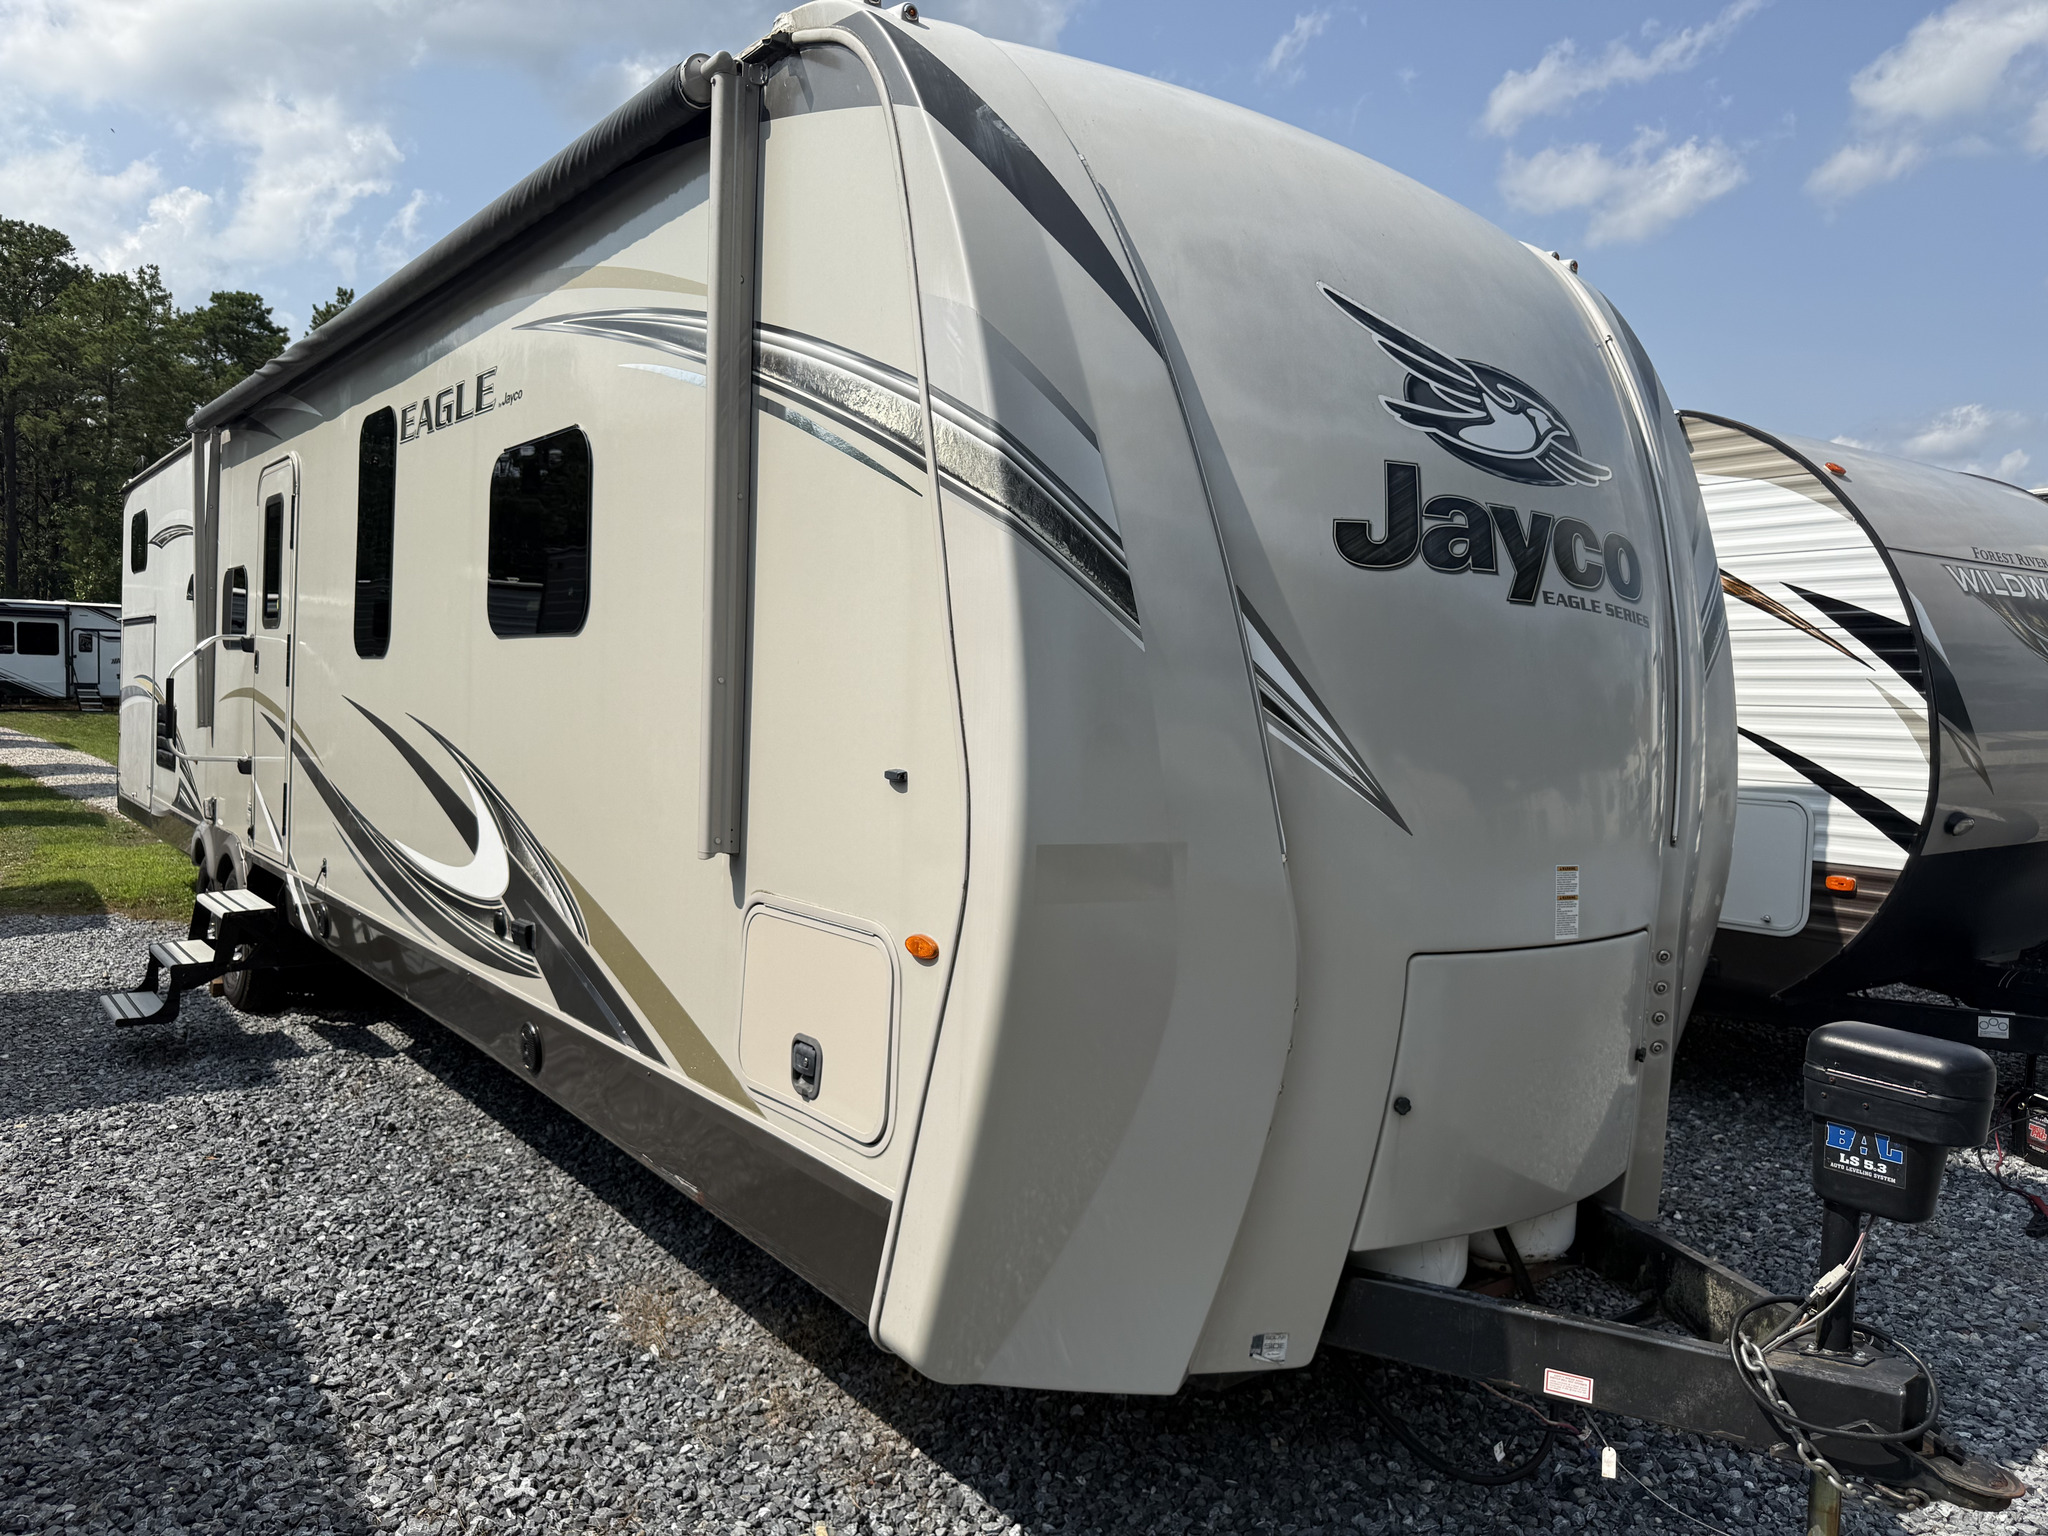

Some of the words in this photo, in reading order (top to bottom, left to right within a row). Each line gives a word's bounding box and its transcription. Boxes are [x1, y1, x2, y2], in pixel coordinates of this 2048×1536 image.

[400, 365, 497, 444] EAGLE
[502, 389, 523, 406] Jayco
[1333, 459, 1644, 606] Jayco
[1971, 546, 2015, 564] FOREST
[2015, 553, 2048, 568] RIVER
[1542, 590, 1602, 614] EAGLE
[1604, 603, 1650, 629] SERIES
[1830, 1162, 1845, 1170] AUTO
[1846, 1165, 1873, 1177] LEVELING
[1873, 1173, 1896, 1184] SYSTEM
[1840, 1153, 1860, 1167] LS
[1864, 1159, 1888, 1174] 5.3
